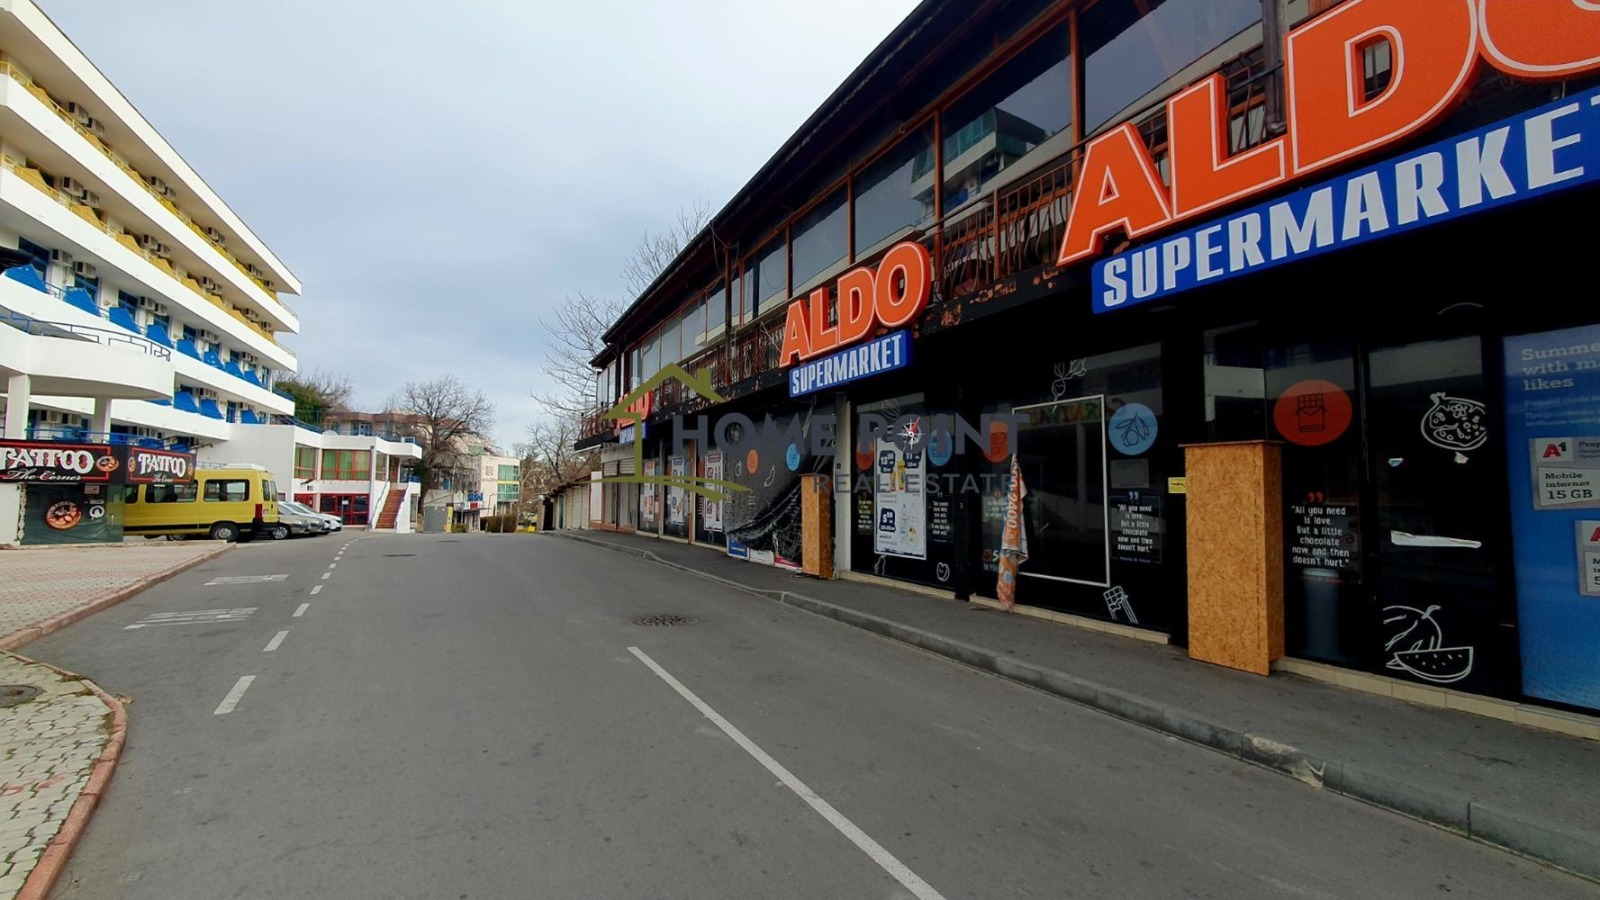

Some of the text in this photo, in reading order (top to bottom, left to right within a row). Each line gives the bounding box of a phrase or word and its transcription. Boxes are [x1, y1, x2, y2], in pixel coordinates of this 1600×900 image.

[1103, 93, 1600, 308] SUPERMARKE
[779, 240, 930, 367] ALDO
[792, 333, 903, 395] SUPERMARKET
[1522, 359, 1600, 376] with m
[1523, 377, 1575, 391] likes
[138, 453, 187, 478] TATTOO
[2, 468, 82, 481] The Corner
[1570, 489, 1593, 499] GB
[1307, 506, 1323, 517] you
[1326, 506, 1346, 516] need
[1300, 536, 1340, 546] chocolate
[1312, 547, 1327, 556] and
[1330, 547, 1350, 557] then
